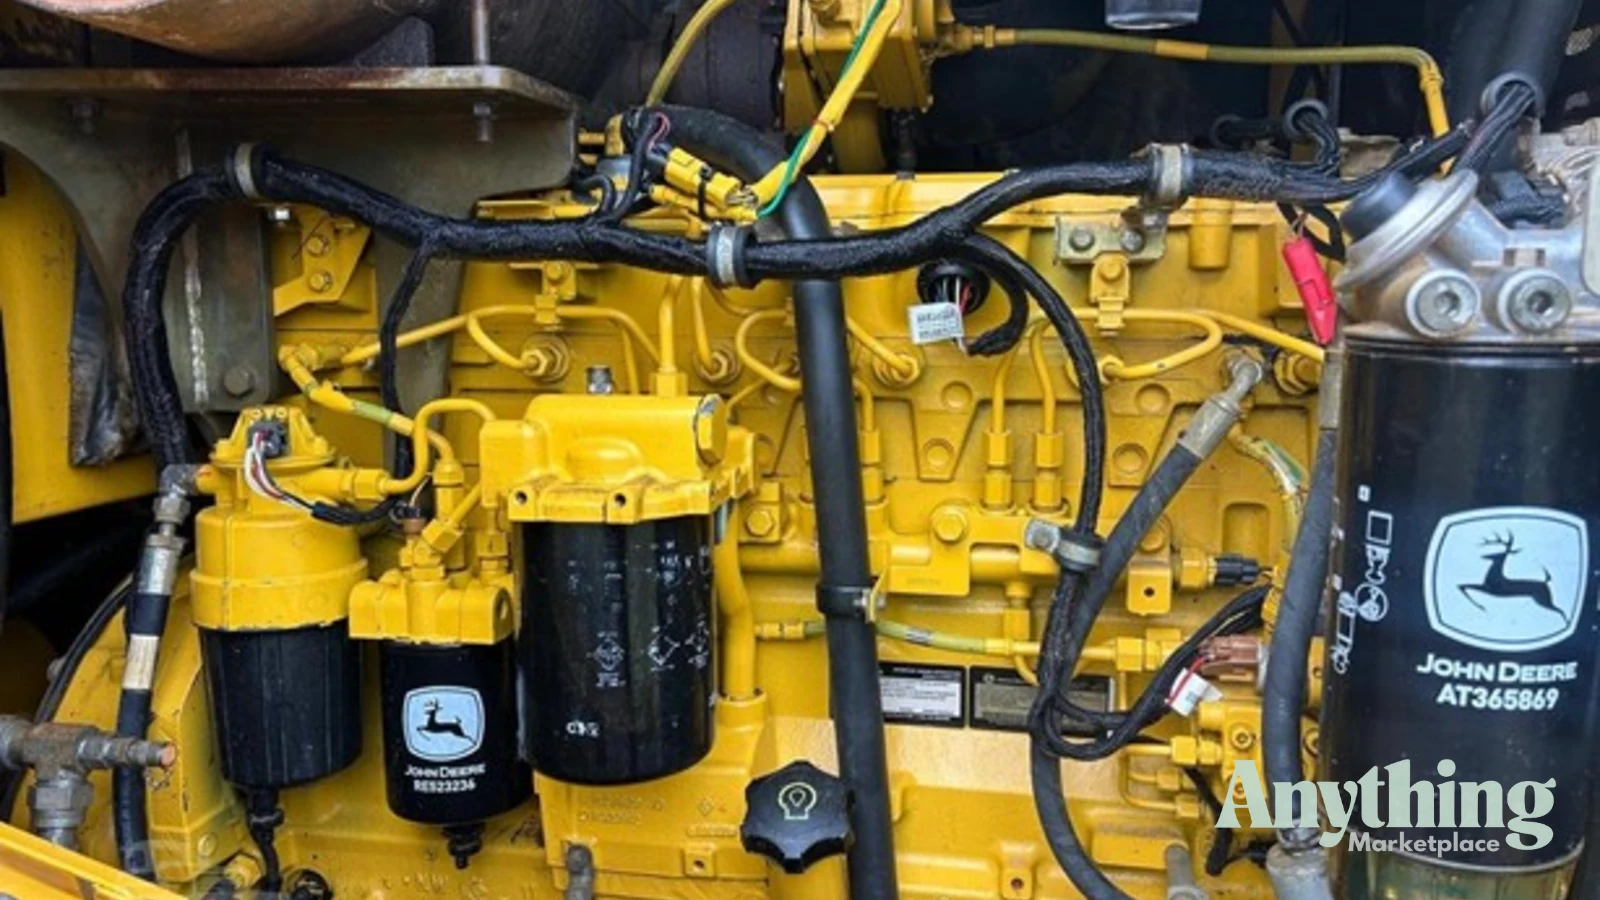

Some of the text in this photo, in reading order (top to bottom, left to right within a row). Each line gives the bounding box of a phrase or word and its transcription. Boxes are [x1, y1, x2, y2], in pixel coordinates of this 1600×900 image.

[1416, 653, 1578, 683] JOHN DEERE
[1436, 683, 1560, 711] AT365869
[404, 763, 486, 778] JOHN DEERE
